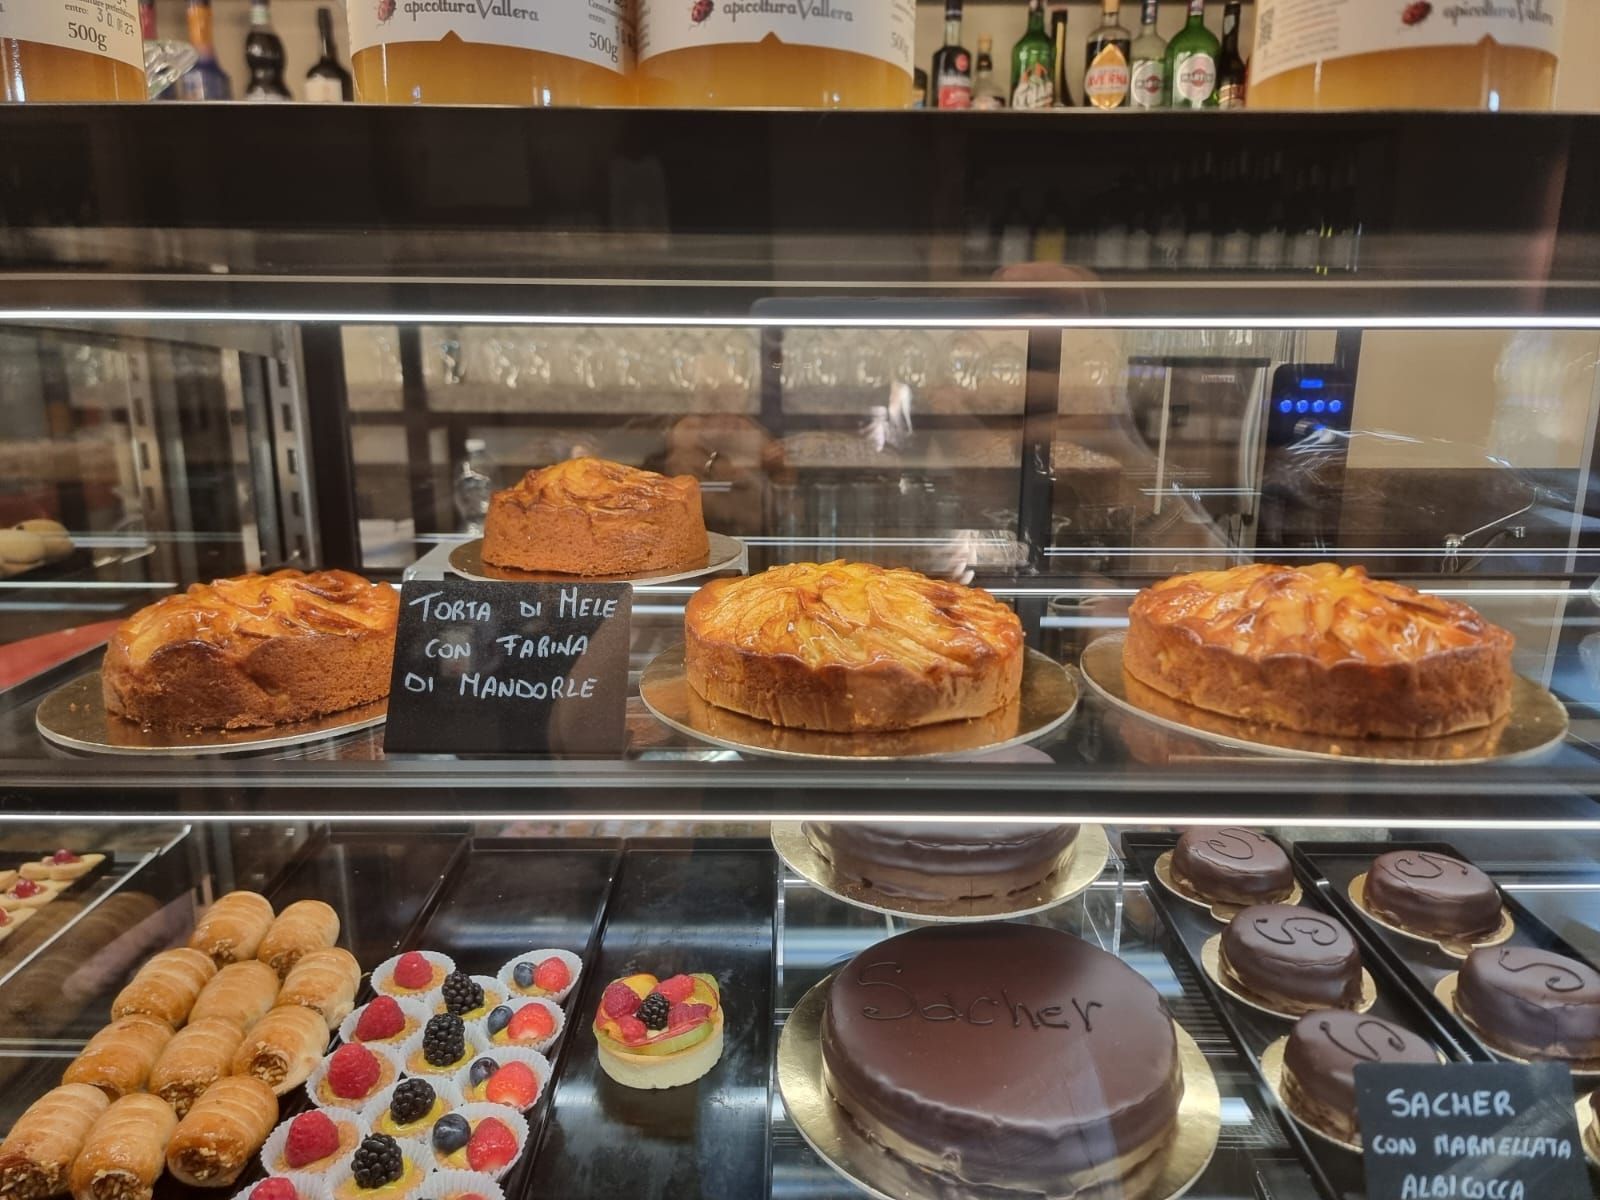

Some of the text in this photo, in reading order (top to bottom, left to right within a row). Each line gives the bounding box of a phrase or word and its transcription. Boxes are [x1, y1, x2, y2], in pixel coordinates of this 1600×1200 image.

[404, 0, 539, 21] apicoltura Vallera
[723, 0, 797, 22] apicoltura
[68, 22, 107, 52] 500g
[589, 32, 618, 63] 500g
[409, 587, 618, 622] TORTA DI MELE
[425, 635, 589, 659] CON FARINA
[405, 672, 598, 700] DI MANDORLE
[857, 962, 1102, 1032] Sacher
[1386, 1088, 1516, 1118] SACHER
[1372, 1134, 1572, 1160] CON MARMELLATA
[1401, 1173, 1525, 1200] ALBICOCCA
